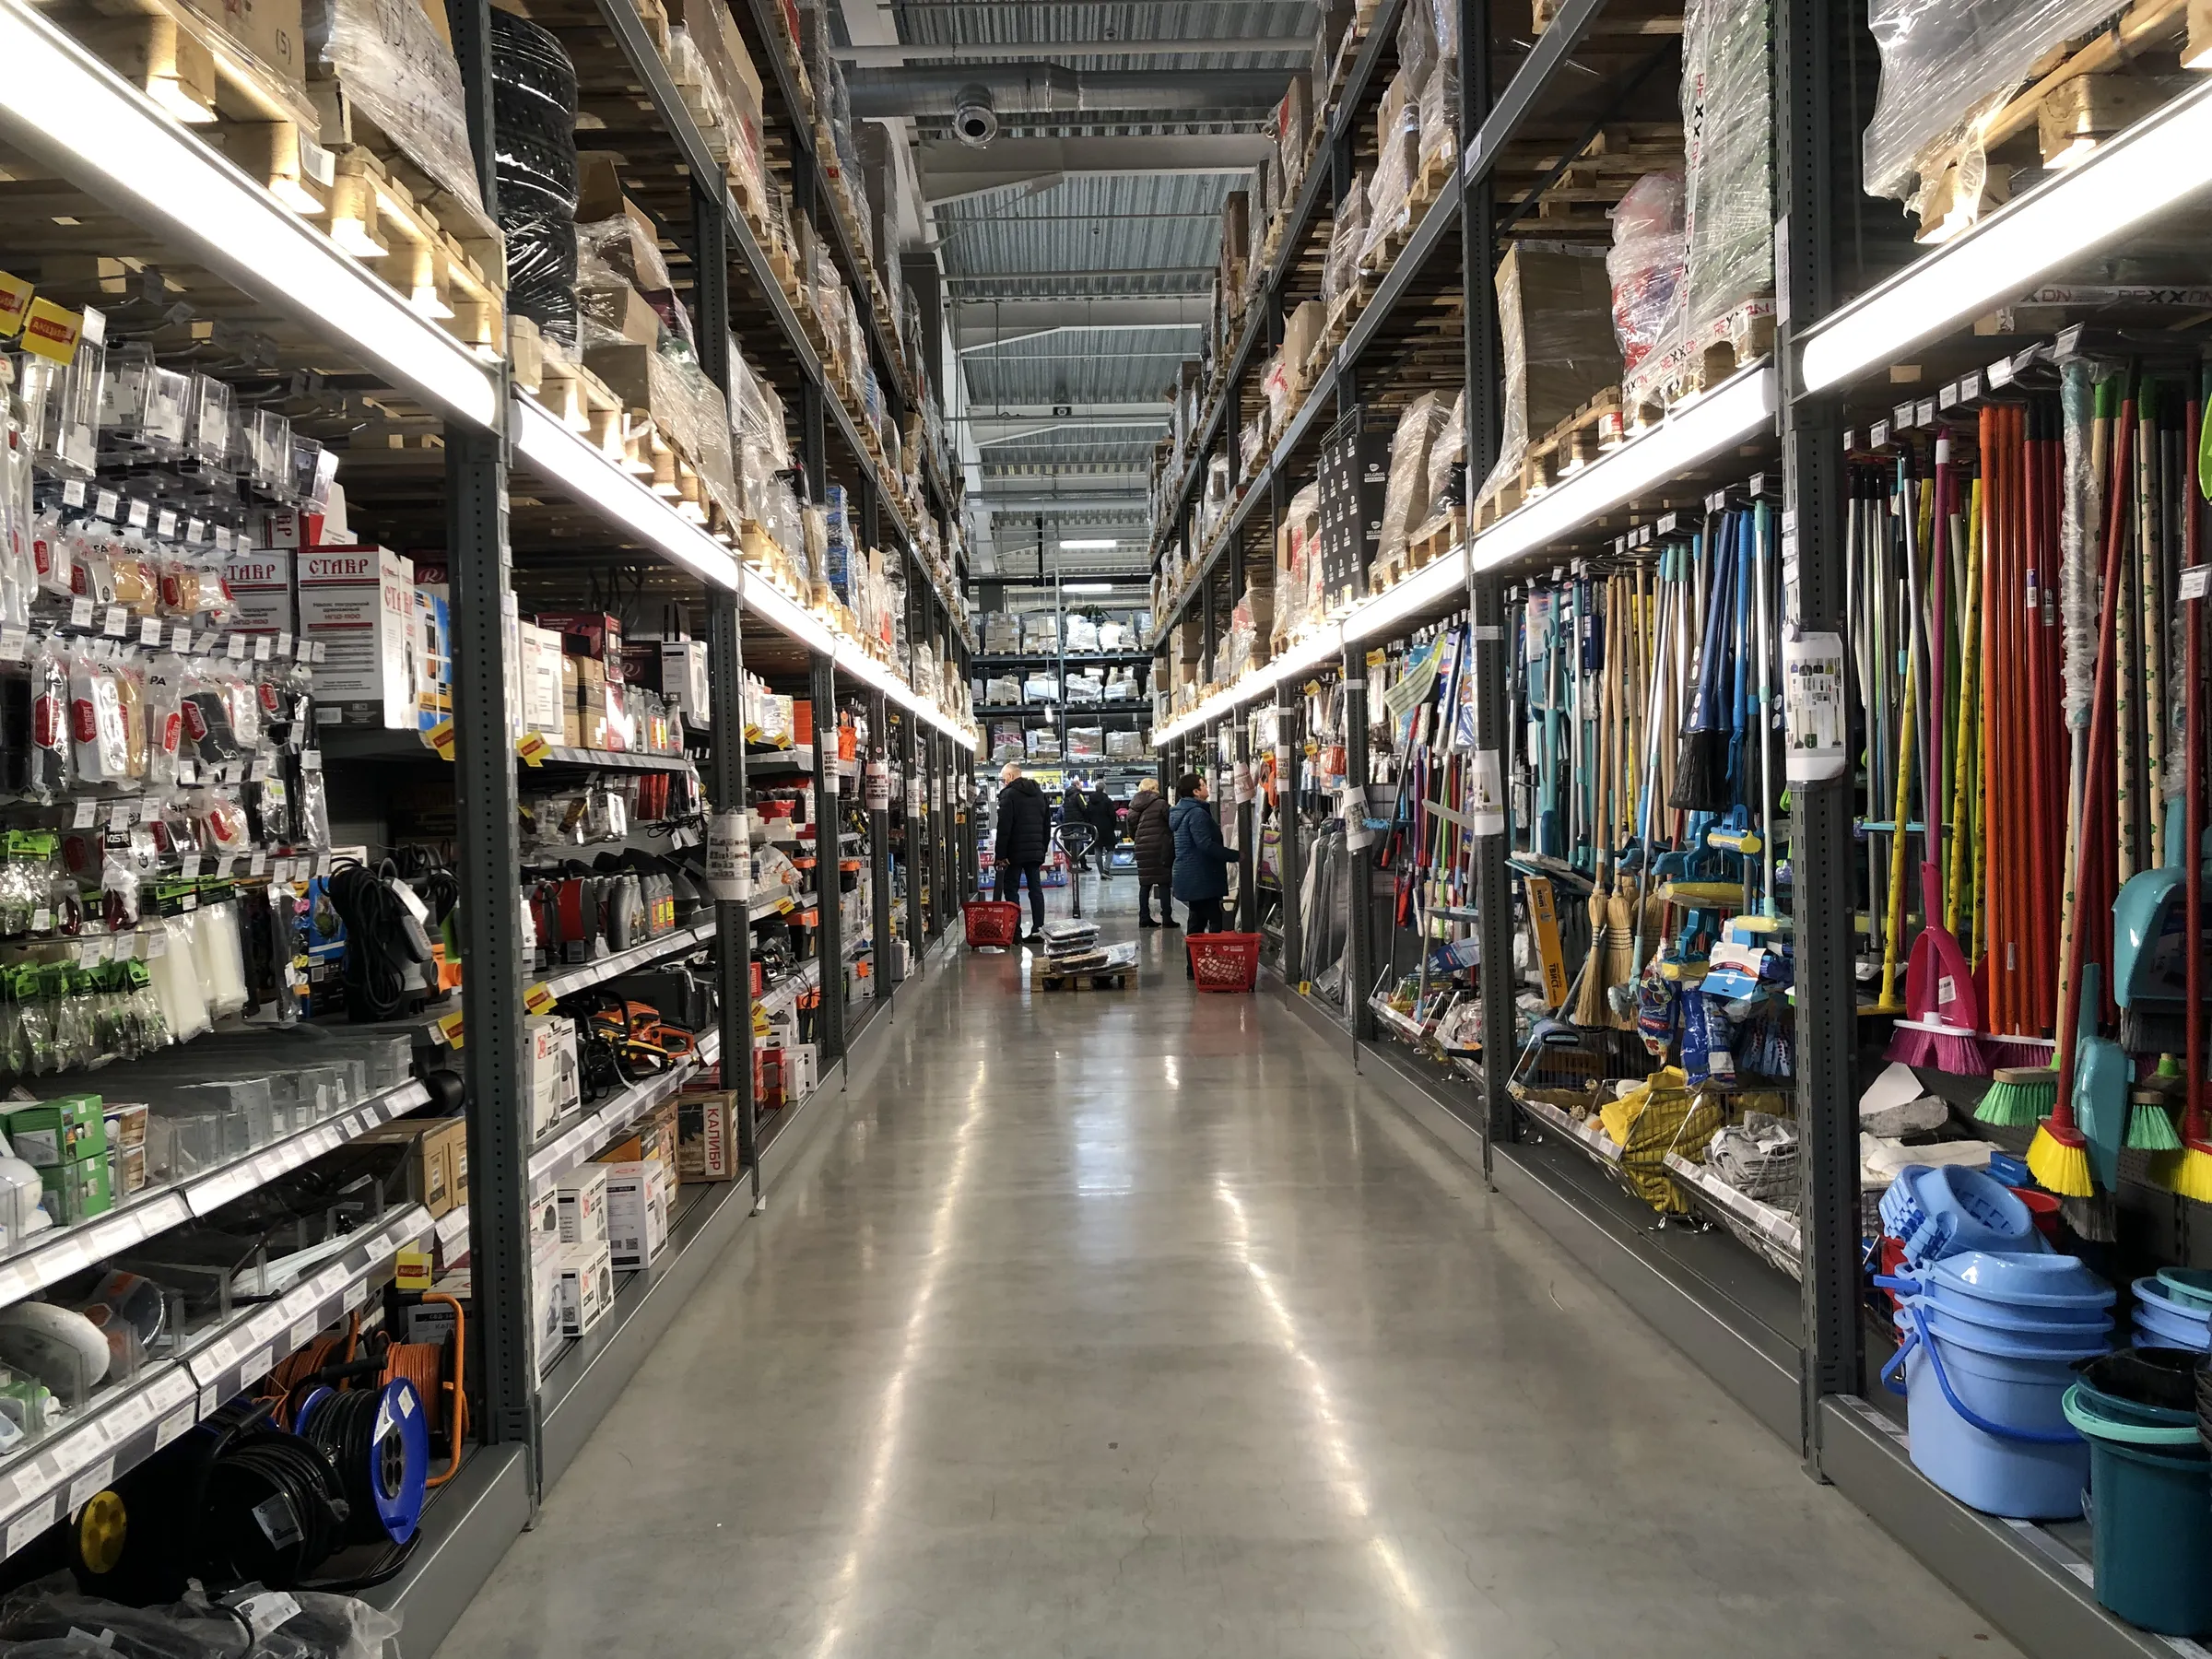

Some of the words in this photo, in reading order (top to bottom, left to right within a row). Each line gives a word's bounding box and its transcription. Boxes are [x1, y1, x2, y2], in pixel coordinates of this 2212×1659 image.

[276, 29, 292, 65] (5)
[223, 564, 276, 581] ТАВР
[309, 559, 369, 574] СТАВР
[83, 705, 96, 735] ЭКСПЕРТ
[1549, 963, 1559, 988] ТВИСТ
[707, 1108, 721, 1171] КАЛИБР
